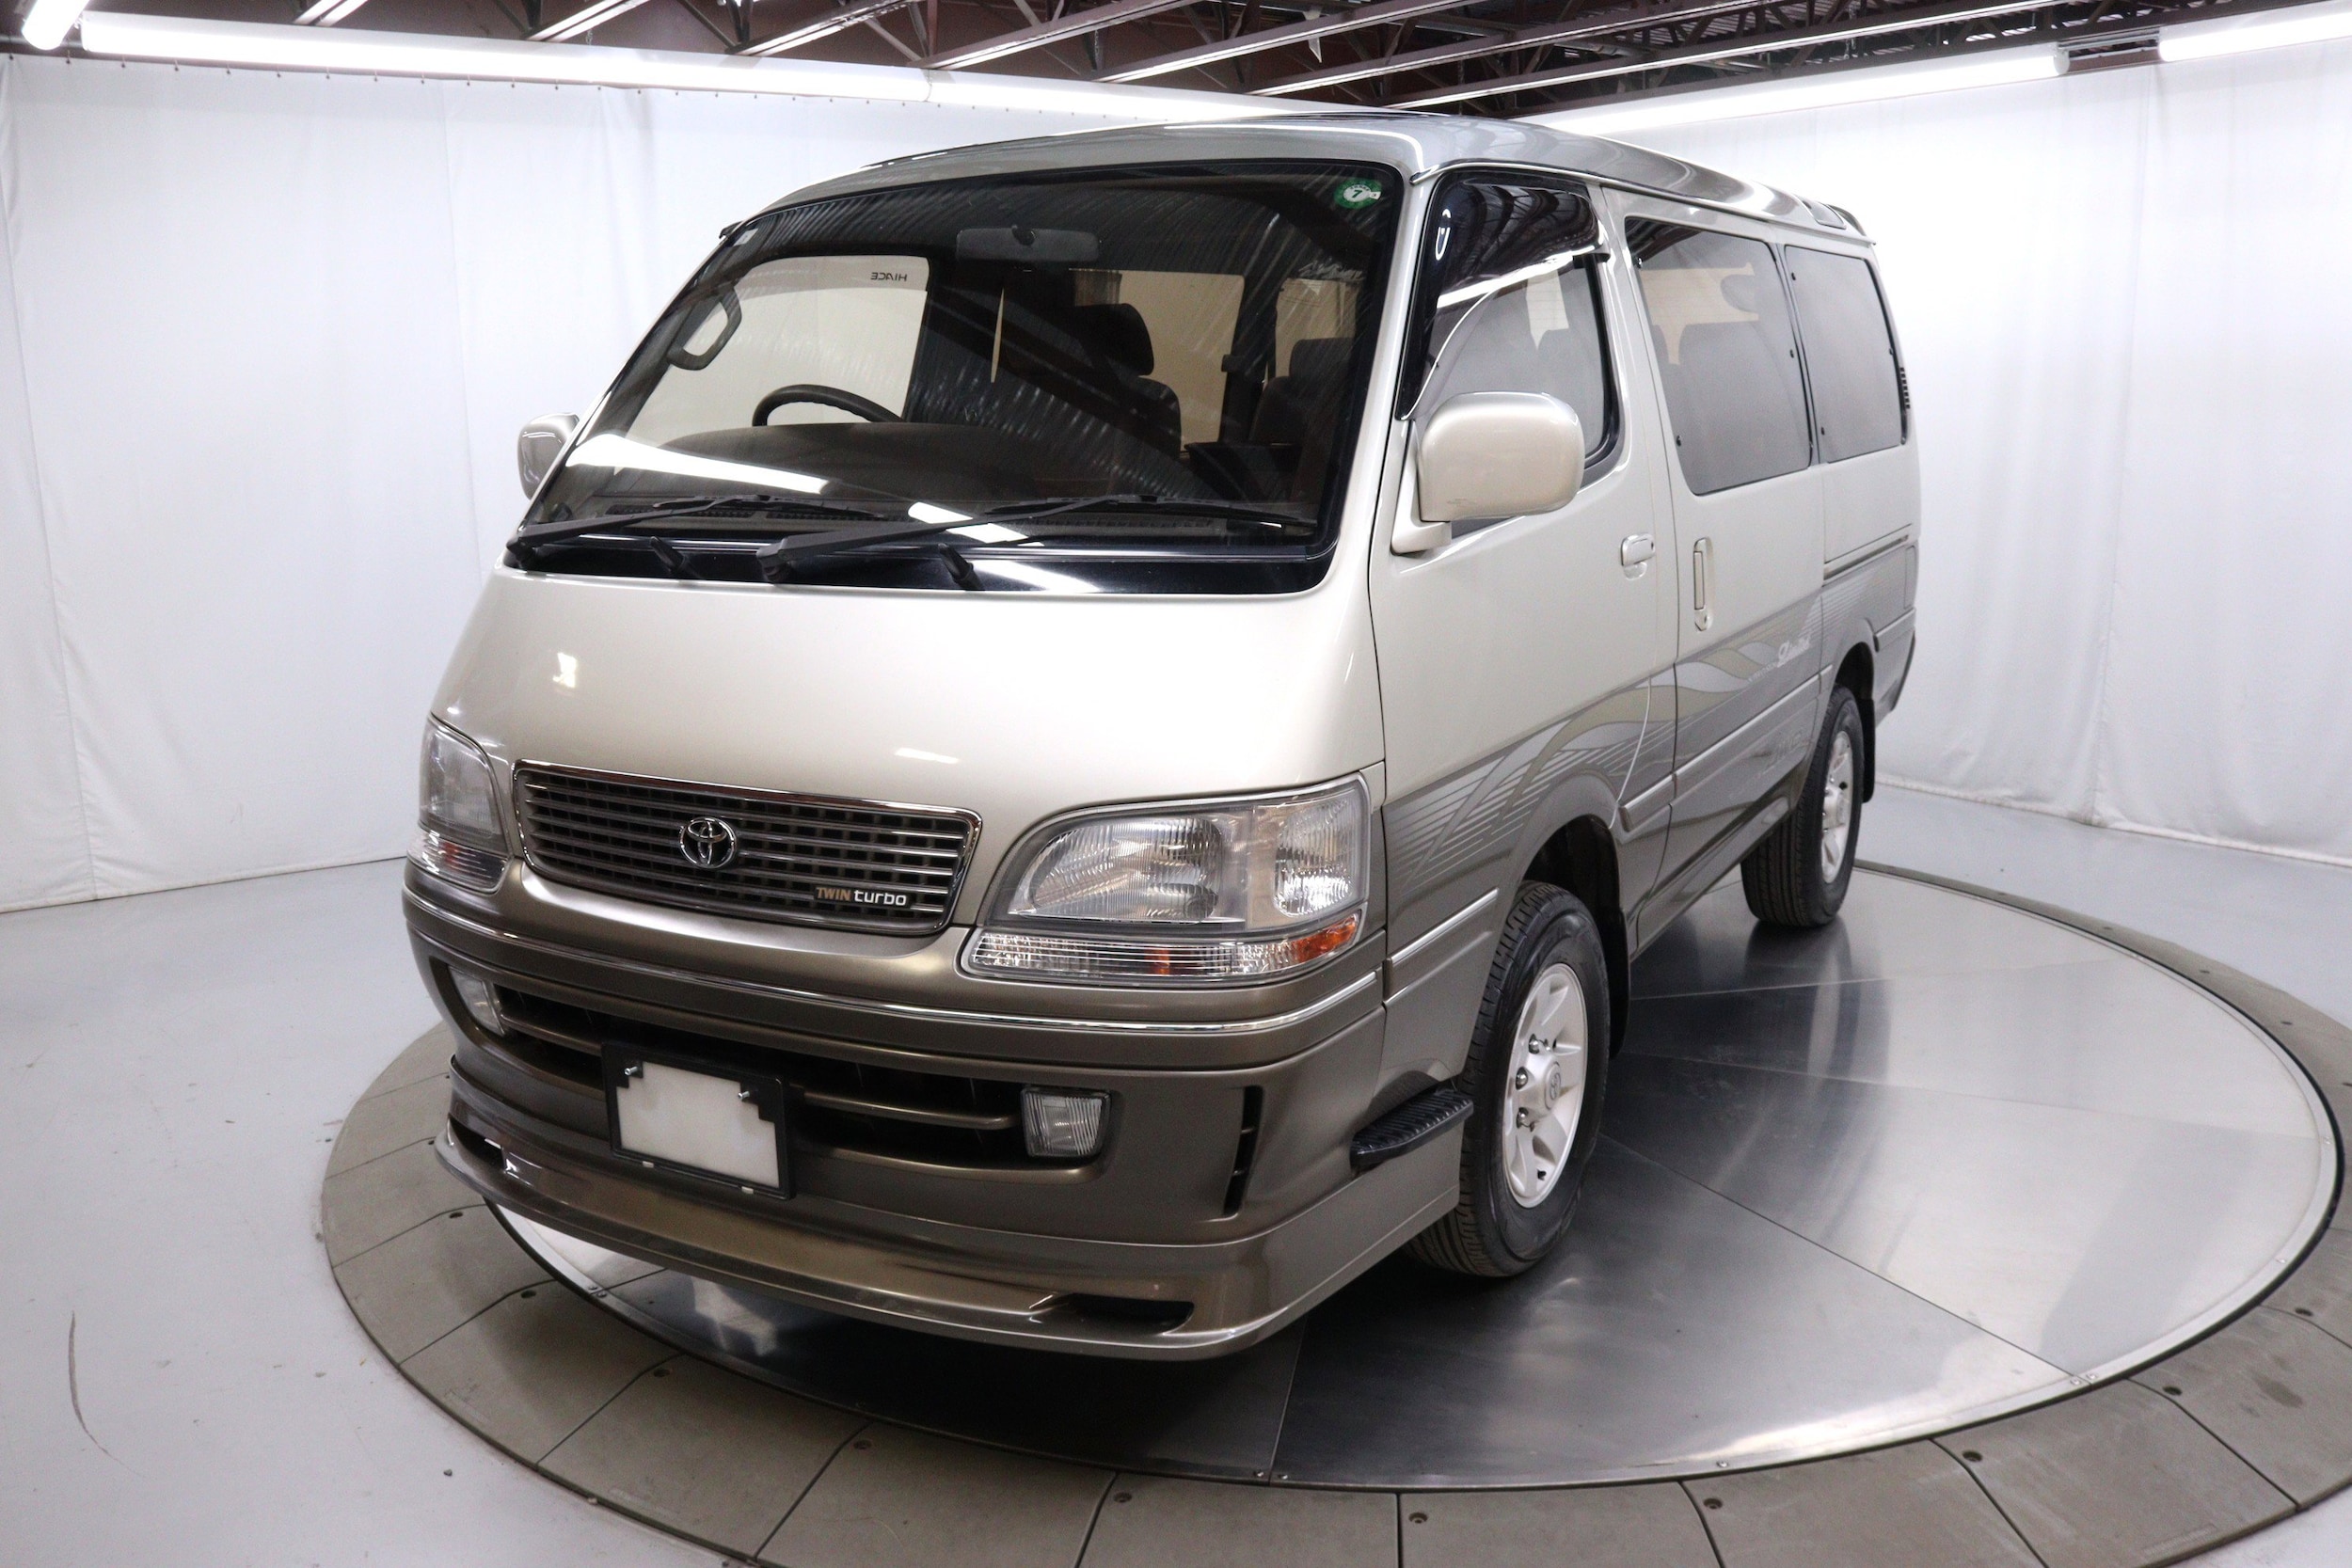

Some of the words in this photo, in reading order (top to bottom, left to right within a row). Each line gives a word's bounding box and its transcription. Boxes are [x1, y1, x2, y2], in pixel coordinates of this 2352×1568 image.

[1351, 189, 1363, 198] 7
[816, 886, 852, 902] TWIN
[853, 889, 908, 906] turbo
